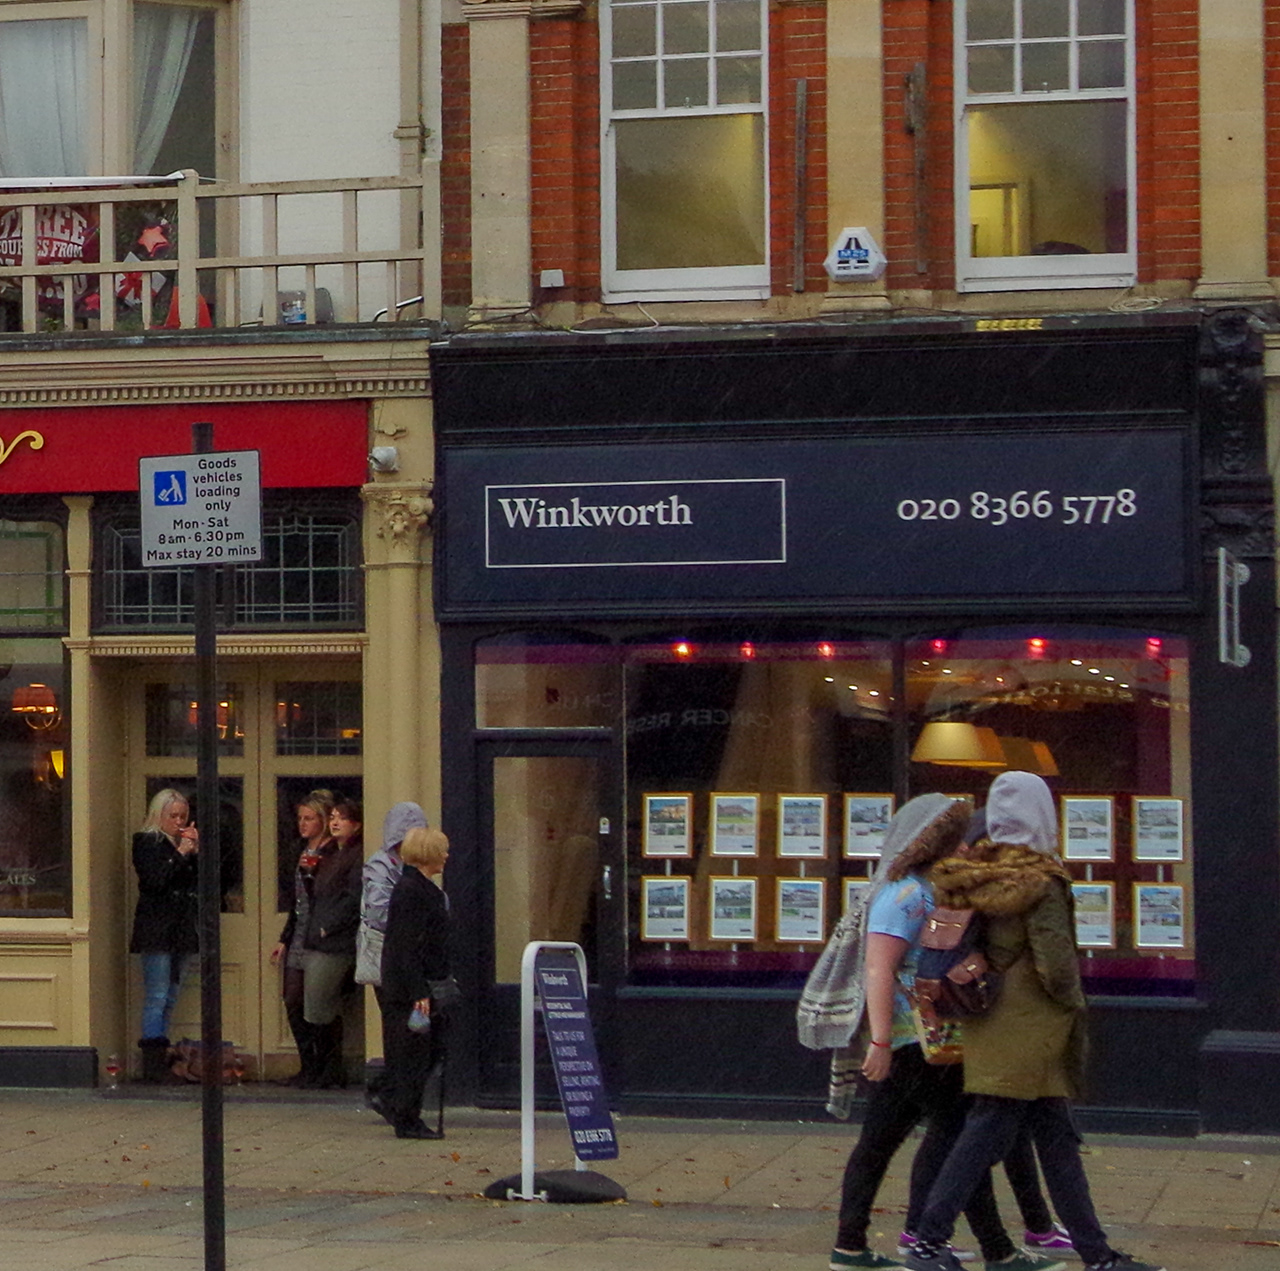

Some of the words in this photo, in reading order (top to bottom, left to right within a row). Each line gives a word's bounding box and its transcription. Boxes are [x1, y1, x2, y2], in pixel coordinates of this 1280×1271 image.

[50, 240, 84, 258] FROM
[198, 458, 237, 469] Goods
[193, 472, 242, 484] vehicles
[195, 486, 240, 498] loading
[205, 500, 231, 512] only
[498, 495, 693, 528] Winkworth
[897, 499, 961, 520] 020
[970, 490, 1054, 526] 8366
[1062, 488, 1137, 524] 5778
[208, 517, 229, 527] Sat
[147, 550, 172, 560] Max
[176, 548, 201, 560] stay
[206, 546, 223, 557] 20
[228, 545, 256, 556] mins
[5, 873, 37, 885] ALES
